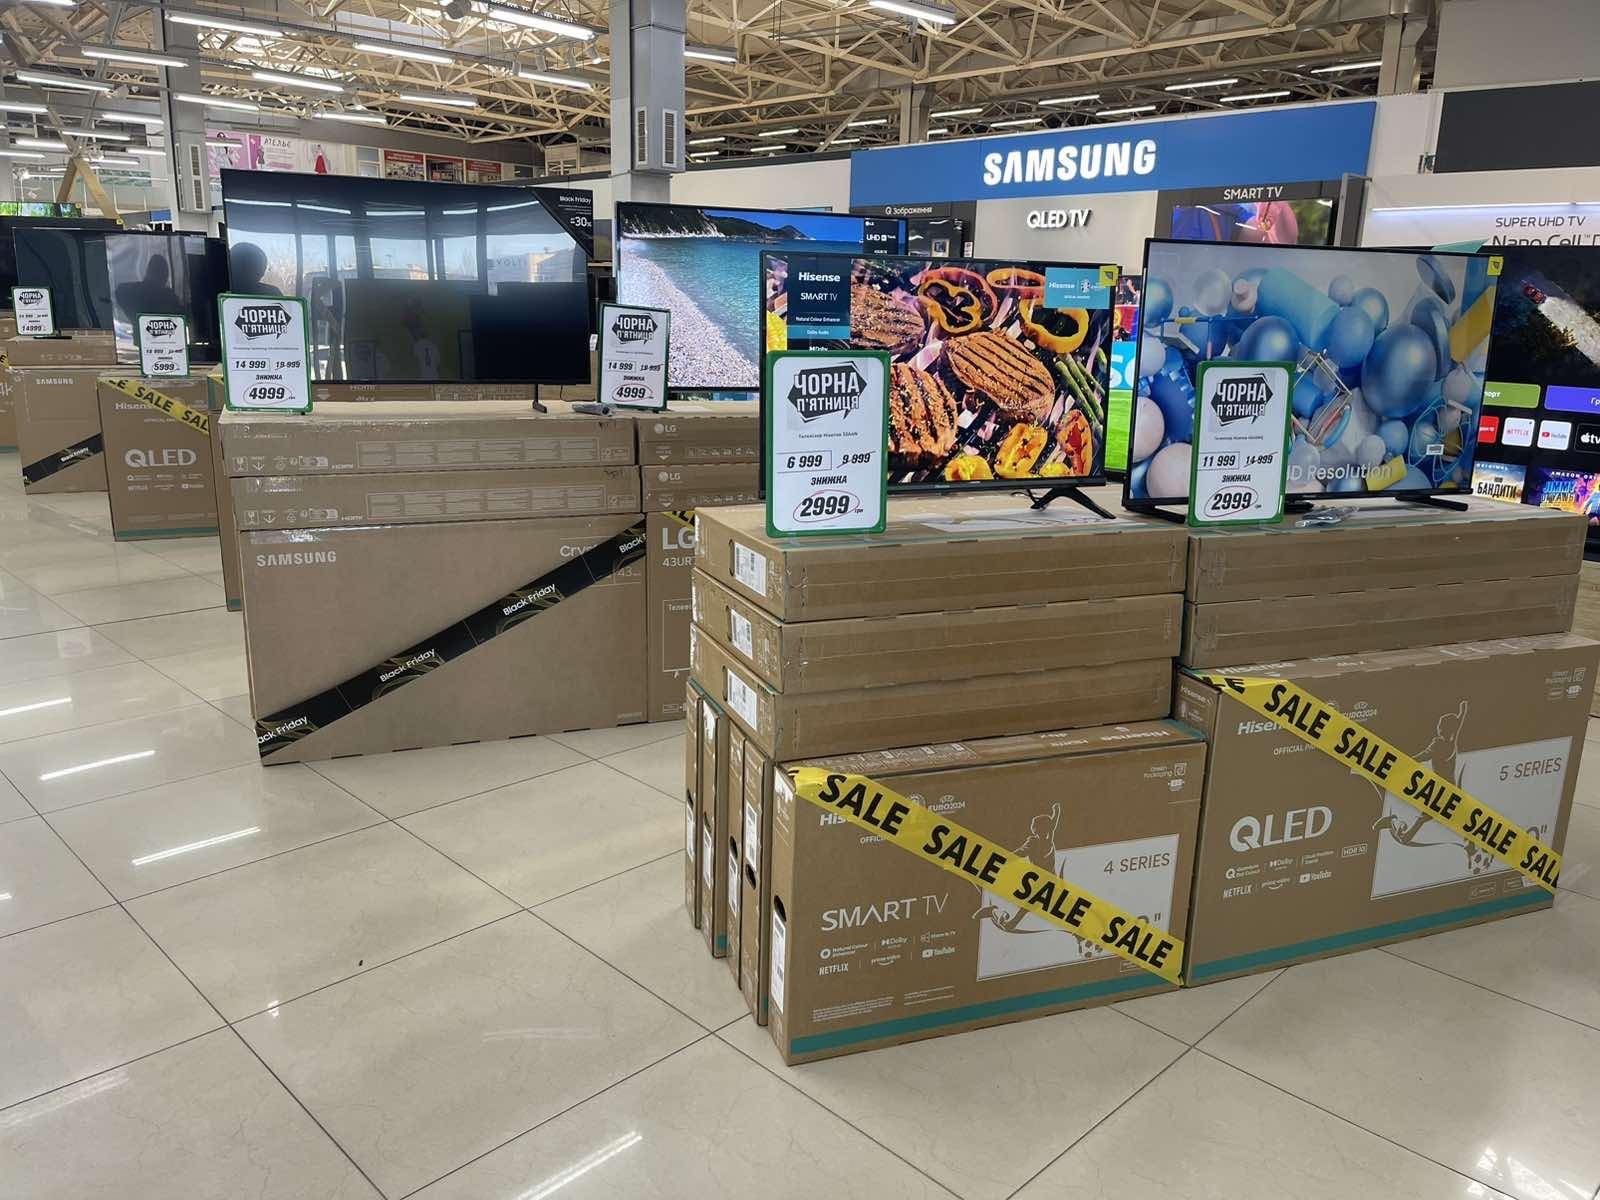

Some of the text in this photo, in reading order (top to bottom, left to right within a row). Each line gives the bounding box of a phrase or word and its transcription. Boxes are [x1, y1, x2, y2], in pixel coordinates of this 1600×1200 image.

[983, 139, 1157, 186] SAMSUNG
[1223, 185, 1284, 201] SMART TV
[1026, 208, 1091, 230] QLED TV
[1495, 215, 1587, 228] SUPER UHD TV
[1492, 234, 1543, 247] Nano
[798, 272, 841, 282] Hisense
[1048, 281, 1075, 289] Hisense
[800, 292, 838, 301] SMART TV
[239, 309, 287, 324] ЧОРНА
[616, 317, 654, 331] ЧОРНА
[148, 320, 176, 331] ЧОРНА
[153, 363, 175, 371] 5999
[235, 360, 266, 369] 14 999
[619, 362, 633, 370] 999
[794, 372, 860, 395] ЧОРНА
[134, 386, 174, 413] SALE
[248, 387, 285, 400] 4999
[616, 386, 646, 399] 4999
[1216, 382, 1267, 402] ЧОРНА
[796, 395, 860, 413] П'ЯТНИЦЯ
[1216, 402, 1266, 417] П'ЯТНИЦЯ
[665, 424, 677, 433] LG
[124, 449, 197, 468] QLED
[786, 454, 823, 469] 6 999
[1202, 454, 1236, 467] 11 999
[1257, 454, 1273, 465] 999
[669, 472, 681, 481] LG
[1222, 473, 1251, 484] ЗНИЖКА
[1307, 463, 1393, 481] Resolution
[1551, 471, 1580, 479] AMAZON
[810, 475, 848, 486] ЗНИЖКА
[1477, 481, 1517, 498] БАНДИТИ
[799, 495, 850, 517] 2999
[1211, 492, 1252, 510] 2999
[618, 536, 644, 554] Black
[662, 527, 695, 550] LG
[256, 550, 337, 567] SAMSUNG
[662, 556, 694, 567] 43UR
[502, 583, 557, 617] Black Friday
[379, 648, 437, 683] Black Friday
[1215, 661, 1297, 675] Hisense
[256, 715, 309, 746] ack Friday
[1237, 720, 1283, 736] Hisen
[1264, 684, 1331, 740] SALE
[1333, 727, 1398, 780] SALE
[1402, 769, 1462, 820] SALE
[1462, 808, 1517, 856] SALE
[1499, 757, 1563, 781] 5 SERIES
[1229, 805, 1333, 853] QLED
[1103, 852, 1171, 875] 4 SERIES
[818, 774, 1174, 969] SALE SALE SALE SALE
[1311, 869, 1332, 880] YouTube
[1223, 885, 1253, 899] NETFLIX
[821, 892, 949, 932] SMART TV
[890, 936, 908, 945] Dolby
[819, 963, 849, 976] NETFLIX
